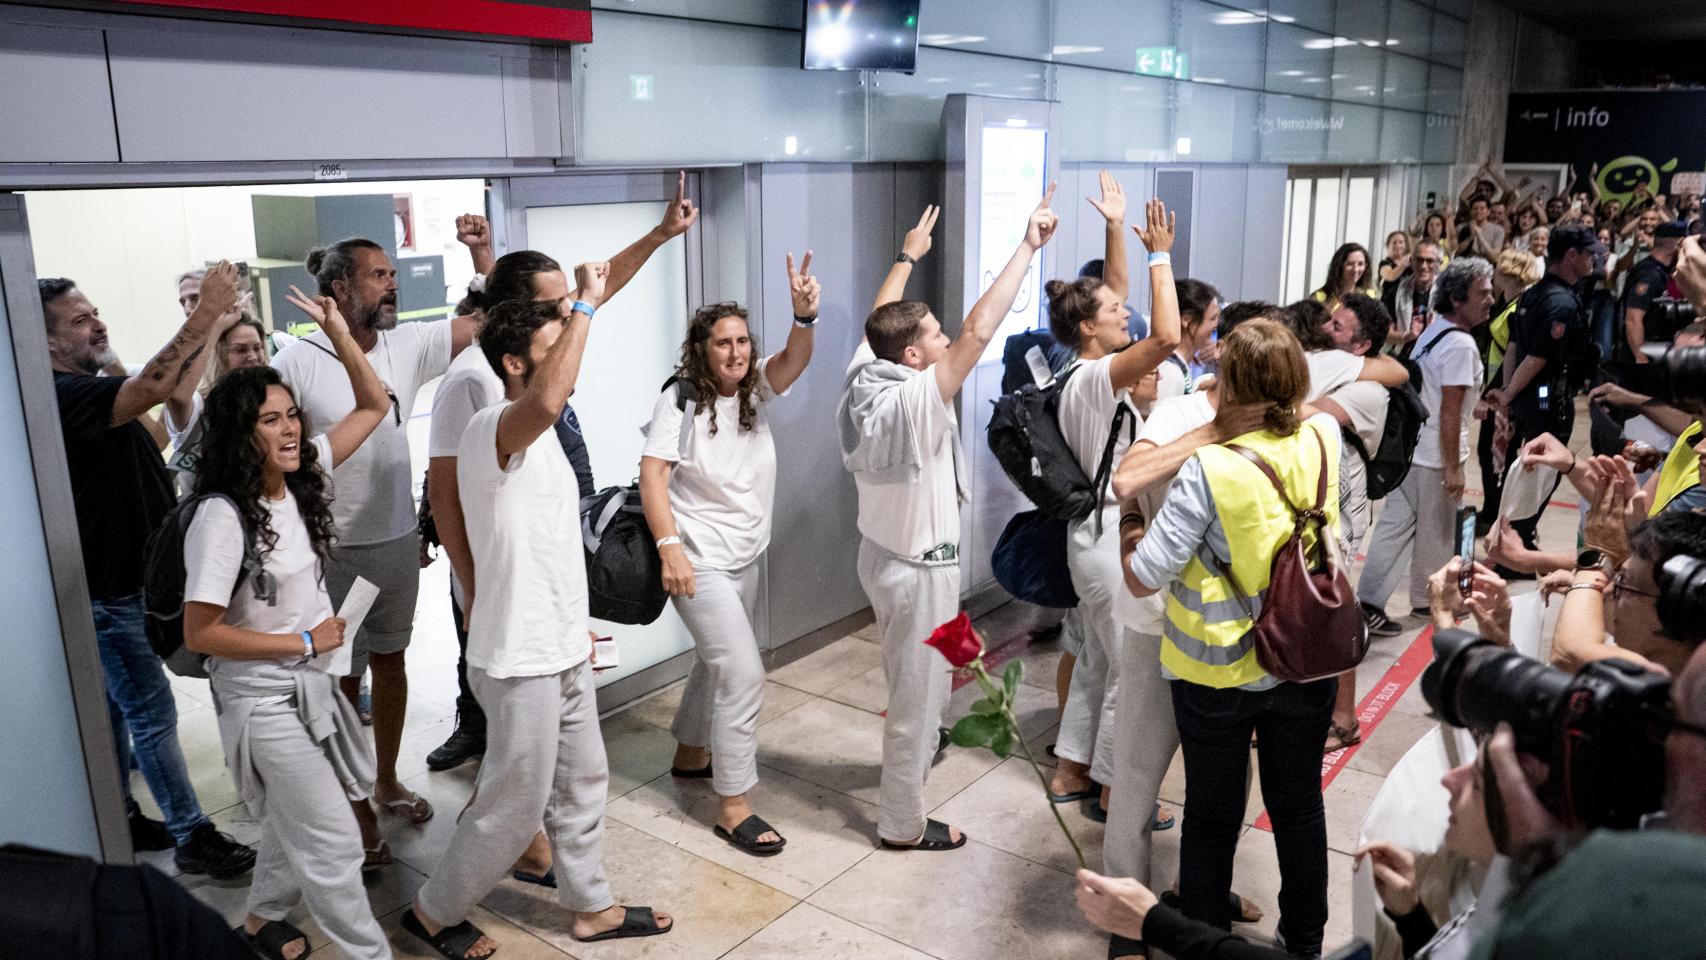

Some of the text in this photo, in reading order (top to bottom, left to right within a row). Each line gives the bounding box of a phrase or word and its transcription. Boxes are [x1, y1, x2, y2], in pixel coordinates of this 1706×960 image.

[1566, 106, 1610, 127] info
[320, 164, 342, 176] 2085
[1358, 681, 1401, 723] DO NOT BLOCK
